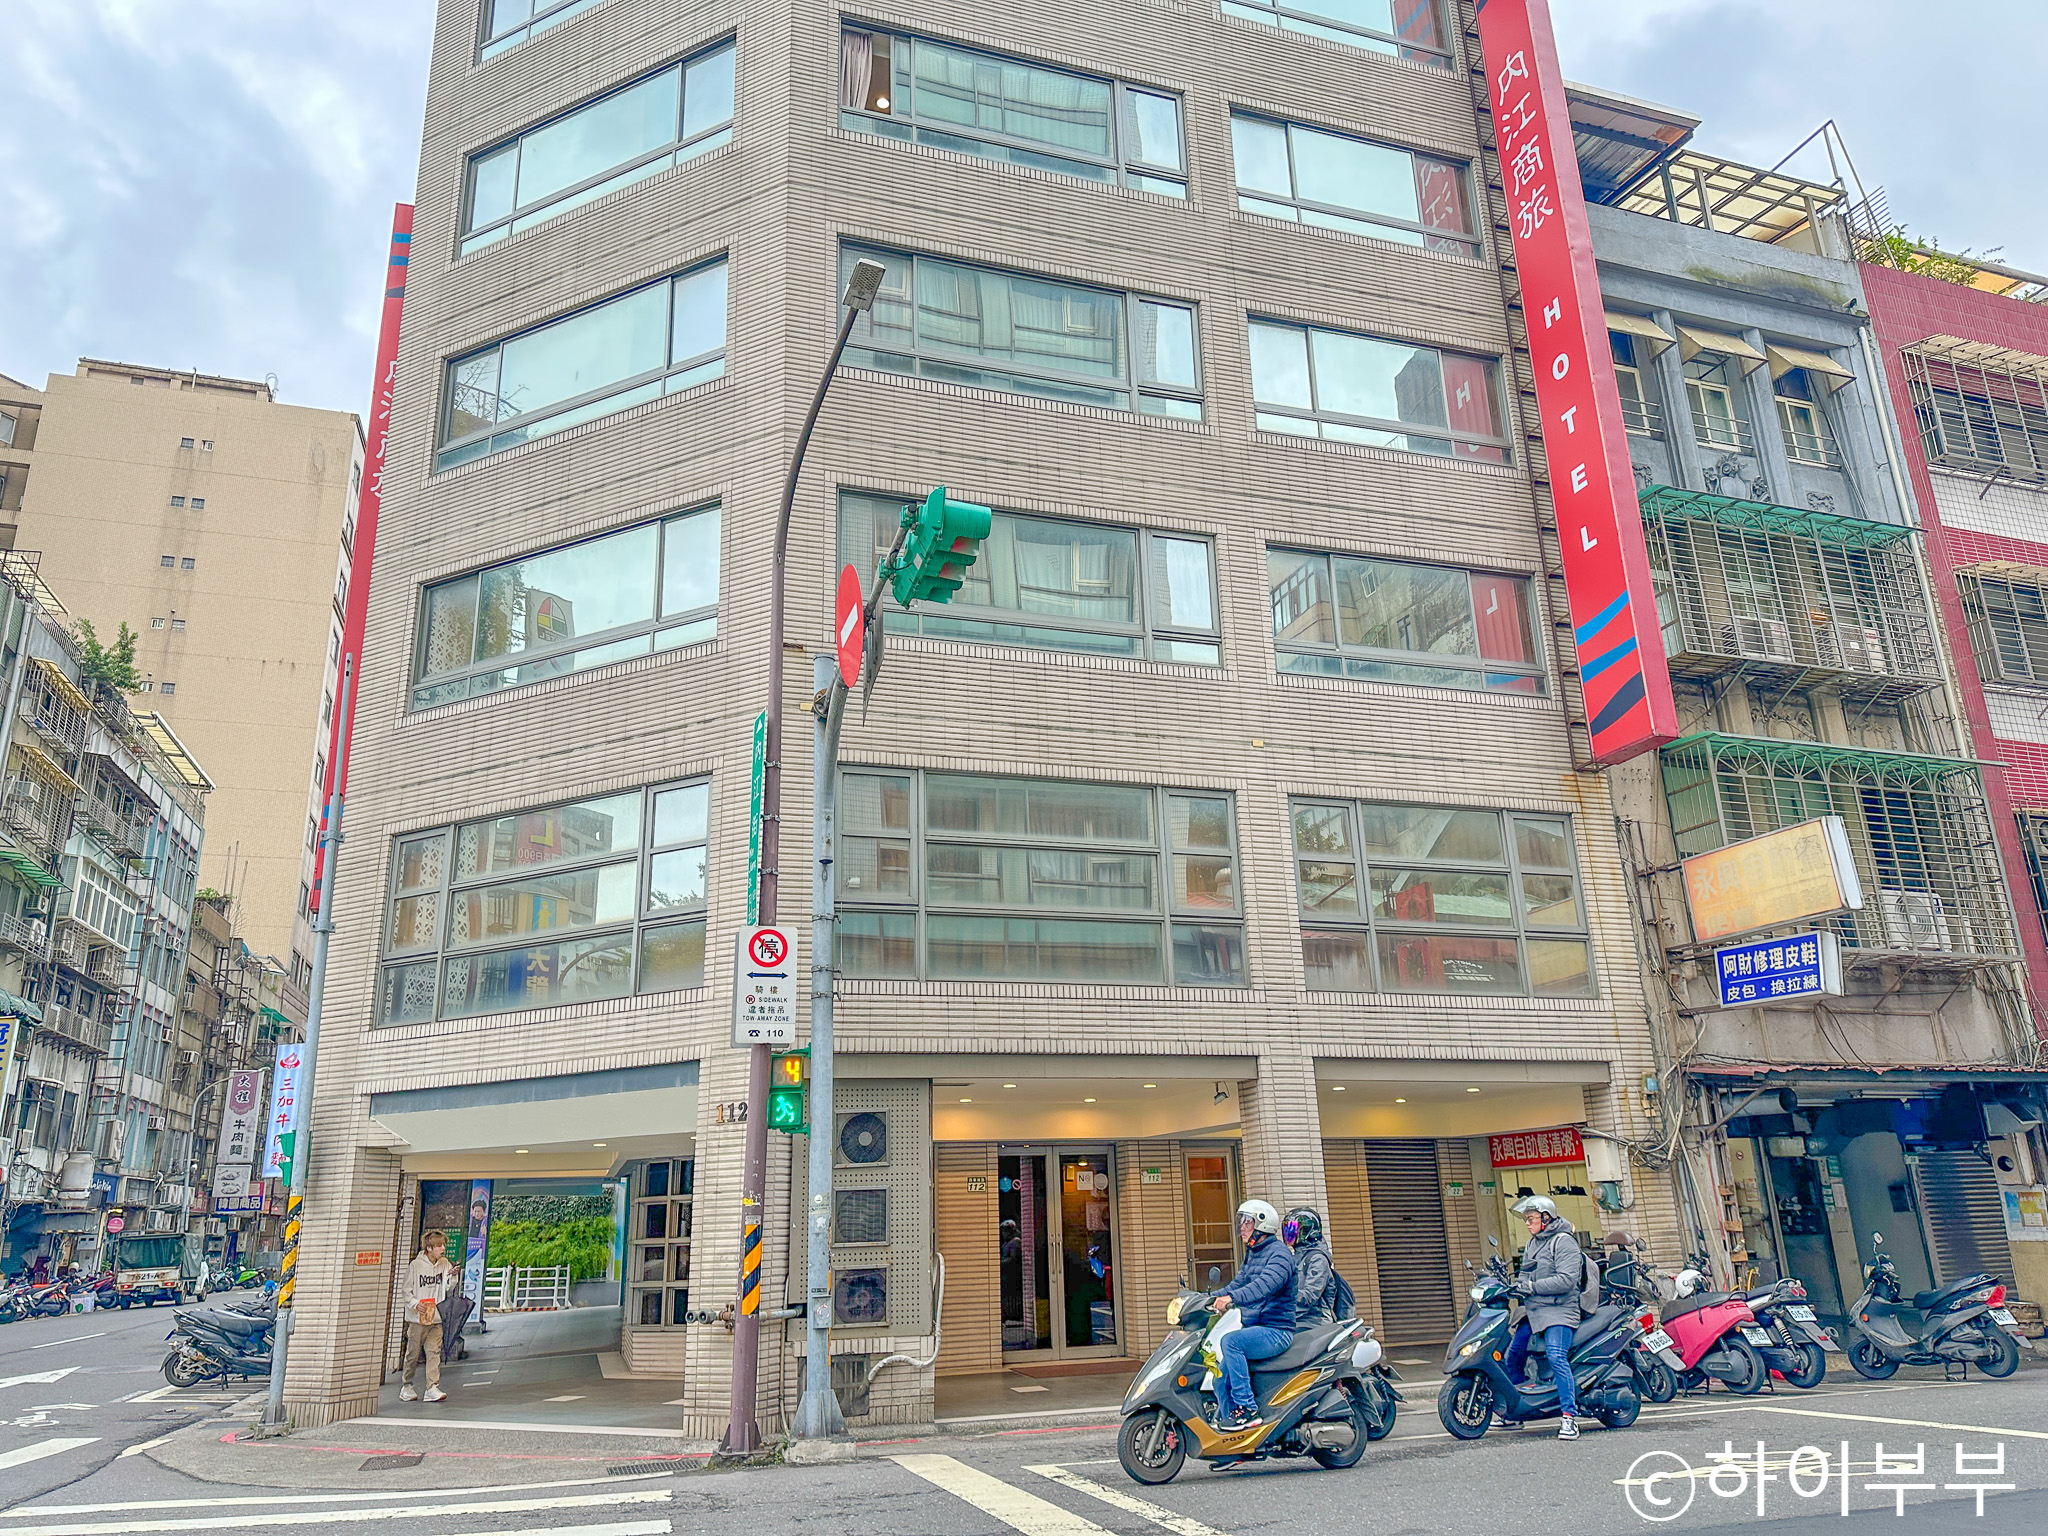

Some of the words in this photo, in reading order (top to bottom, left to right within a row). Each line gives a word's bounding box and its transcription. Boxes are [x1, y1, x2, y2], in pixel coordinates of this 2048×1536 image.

[1543, 296, 1598, 552] HOTEL
[758, 938, 779, 959] 停
[1722, 941, 1818, 979] 阿財修理皮鞋
[748, 1005, 785, 1014] 違者拖吊
[766, 1029, 784, 1037] 110
[786, 1060, 800, 1082] 4
[716, 1101, 748, 1123] 112
[1222, 1434, 1245, 1443] PGO
